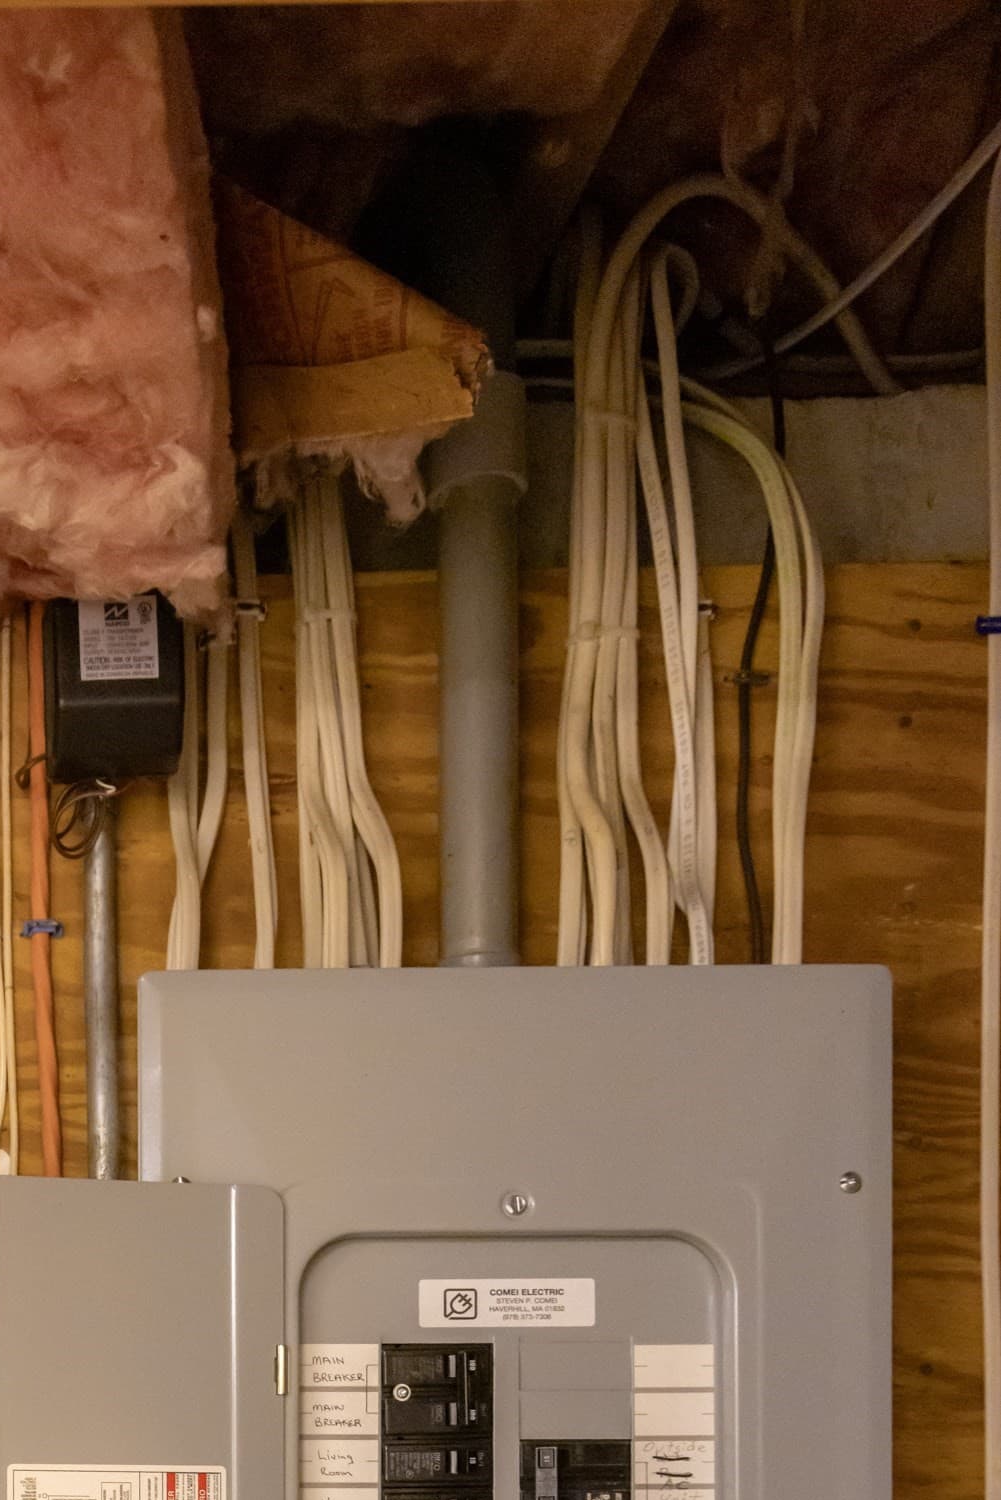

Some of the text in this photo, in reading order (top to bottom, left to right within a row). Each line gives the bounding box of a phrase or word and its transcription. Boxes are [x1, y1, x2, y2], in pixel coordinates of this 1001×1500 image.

[521, 1288, 565, 1296] ELECTRIC
[312, 1356, 345, 1366] MAIN
[312, 1372, 365, 1383] BREAKER
[312, 1403, 345, 1412] MAIN
[314, 1418, 363, 1428] BREAKER
[317, 1449, 354, 1464] Living
